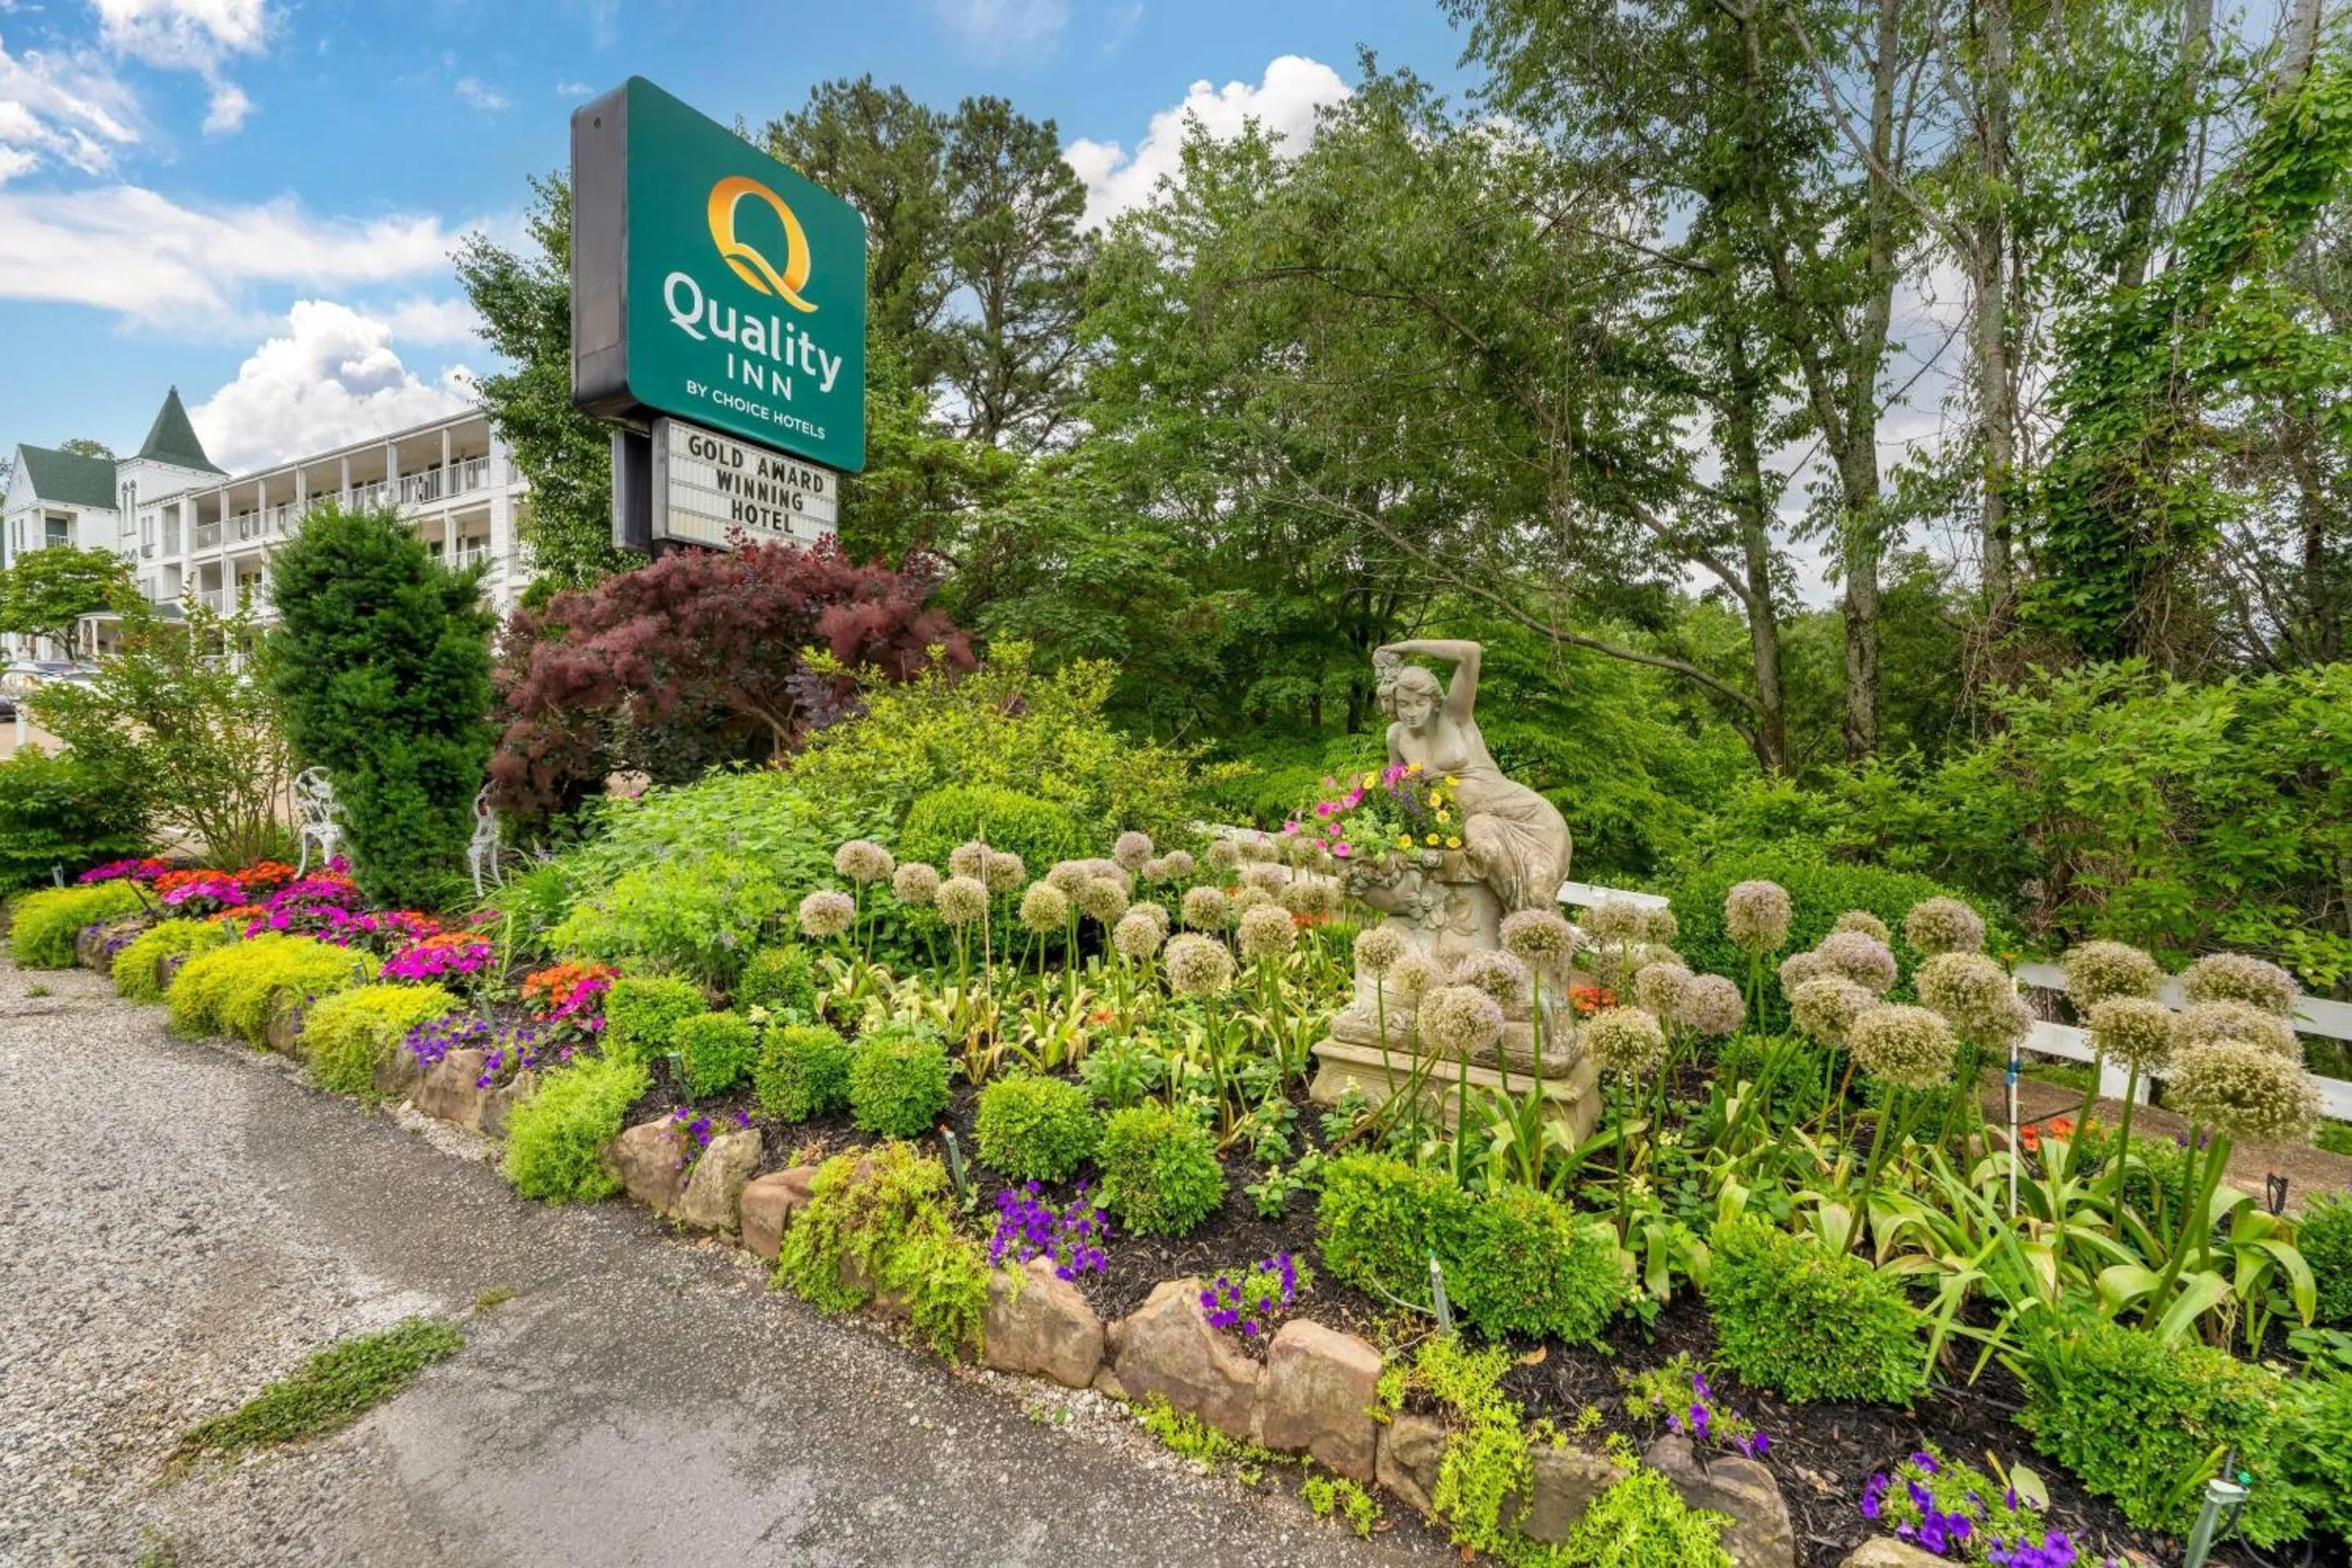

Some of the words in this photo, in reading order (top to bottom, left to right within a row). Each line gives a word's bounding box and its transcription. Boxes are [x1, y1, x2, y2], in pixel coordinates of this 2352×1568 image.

[707, 176, 818, 312] Q
[664, 271, 842, 393] Quality
[728, 353, 791, 401] INN
[686, 380, 708, 398] BY
[713, 390, 769, 419] CHOICE
[773, 411, 826, 439] HOTELS
[688, 435, 744, 468] GOLD
[757, 457, 824, 493] AWARD
[716, 470, 804, 512] WINNING
[732, 500, 794, 534] HOTEL
